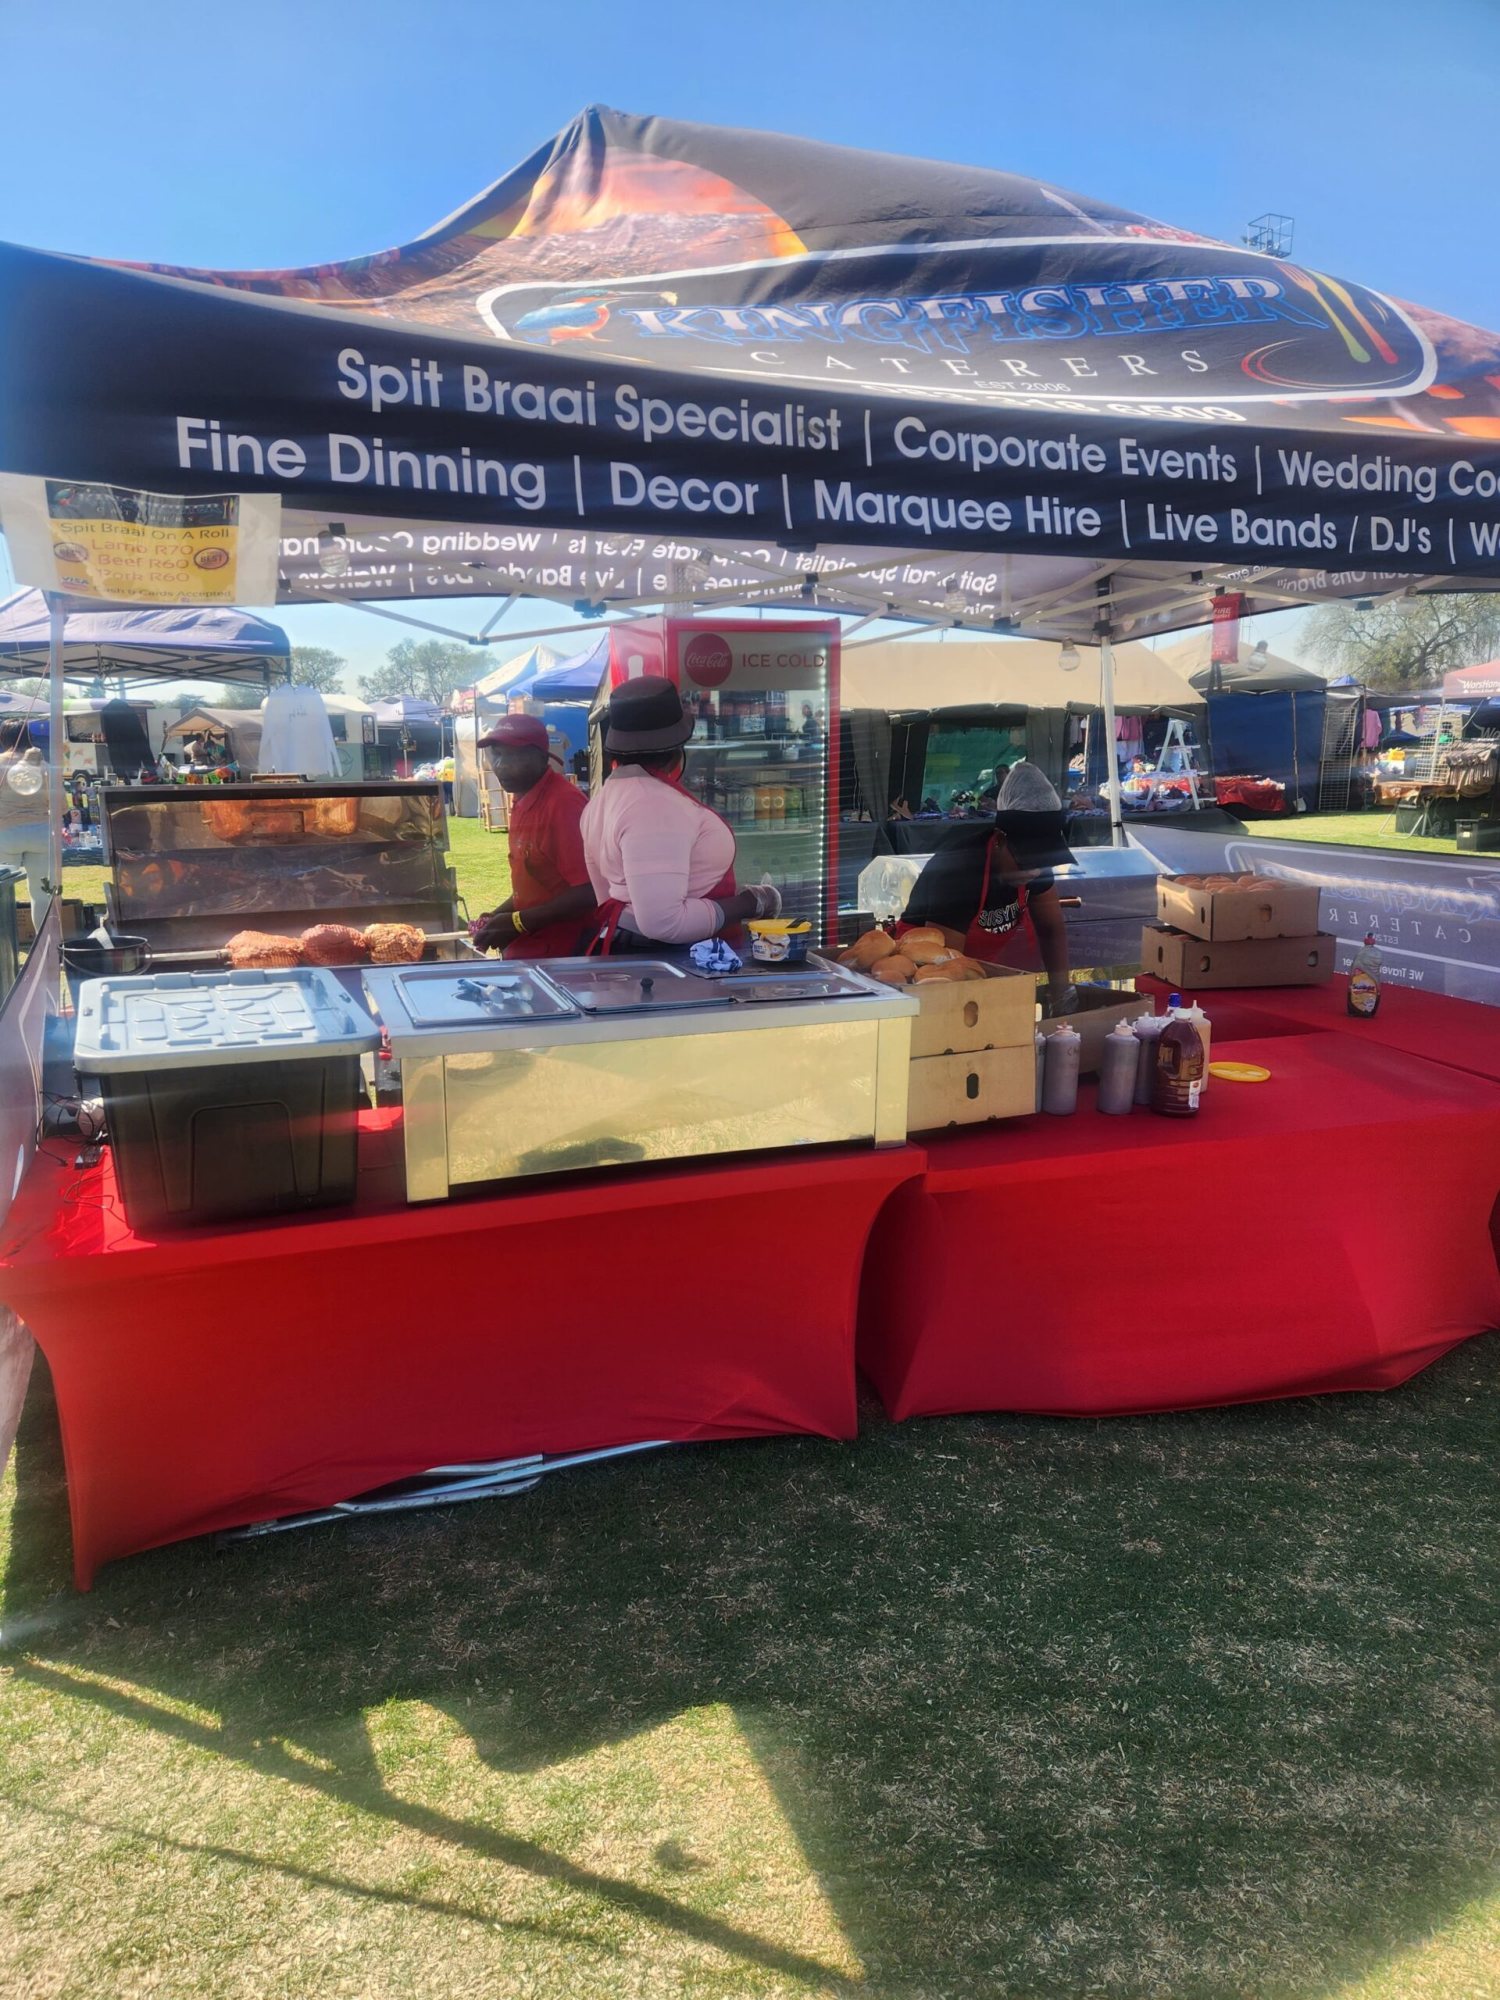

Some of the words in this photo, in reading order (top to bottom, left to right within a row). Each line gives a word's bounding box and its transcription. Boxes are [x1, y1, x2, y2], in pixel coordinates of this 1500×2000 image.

[619, 275, 1329, 353] KINGFISHER
[750, 350, 1208, 378] CATERERS
[973, 380, 1018, 392] EST
[1024, 381, 1071, 393] 2006
[1106, 401, 1247, 423] 6509
[337, 348, 443, 412] Spit
[463, 365, 596, 426] Braai
[614, 384, 841, 450] Specialist
[894, 416, 1107, 473] Corporate
[1119, 437, 1238, 482] Events
[1278, 449, 1437, 503] Wedding
[1449, 460, 1500, 498] Co
[176, 416, 307, 478] Fine
[328, 432, 546, 511] Dinning
[610, 461, 759, 515] Decor
[813, 479, 1011, 535] Marquee
[1025, 495, 1101, 537] Hire
[1147, 503, 1218, 543] Live
[1230, 508, 1337, 549] Bands
[1370, 516, 1432, 554] DJ's
[1469, 521, 1500, 556] W
[60, 523, 96, 535] Spit
[101, 523, 146, 537] Braai
[151, 530, 176, 540] On
[181, 531, 195, 540] A
[199, 529, 230, 539] Roll
[155, 545, 194, 556] R70
[98, 554, 143, 568] Beef
[149, 558, 190, 569] R60
[150, 572, 190, 583] R60
[742, 654, 771, 668] ICE
[777, 654, 825, 668] COLD
